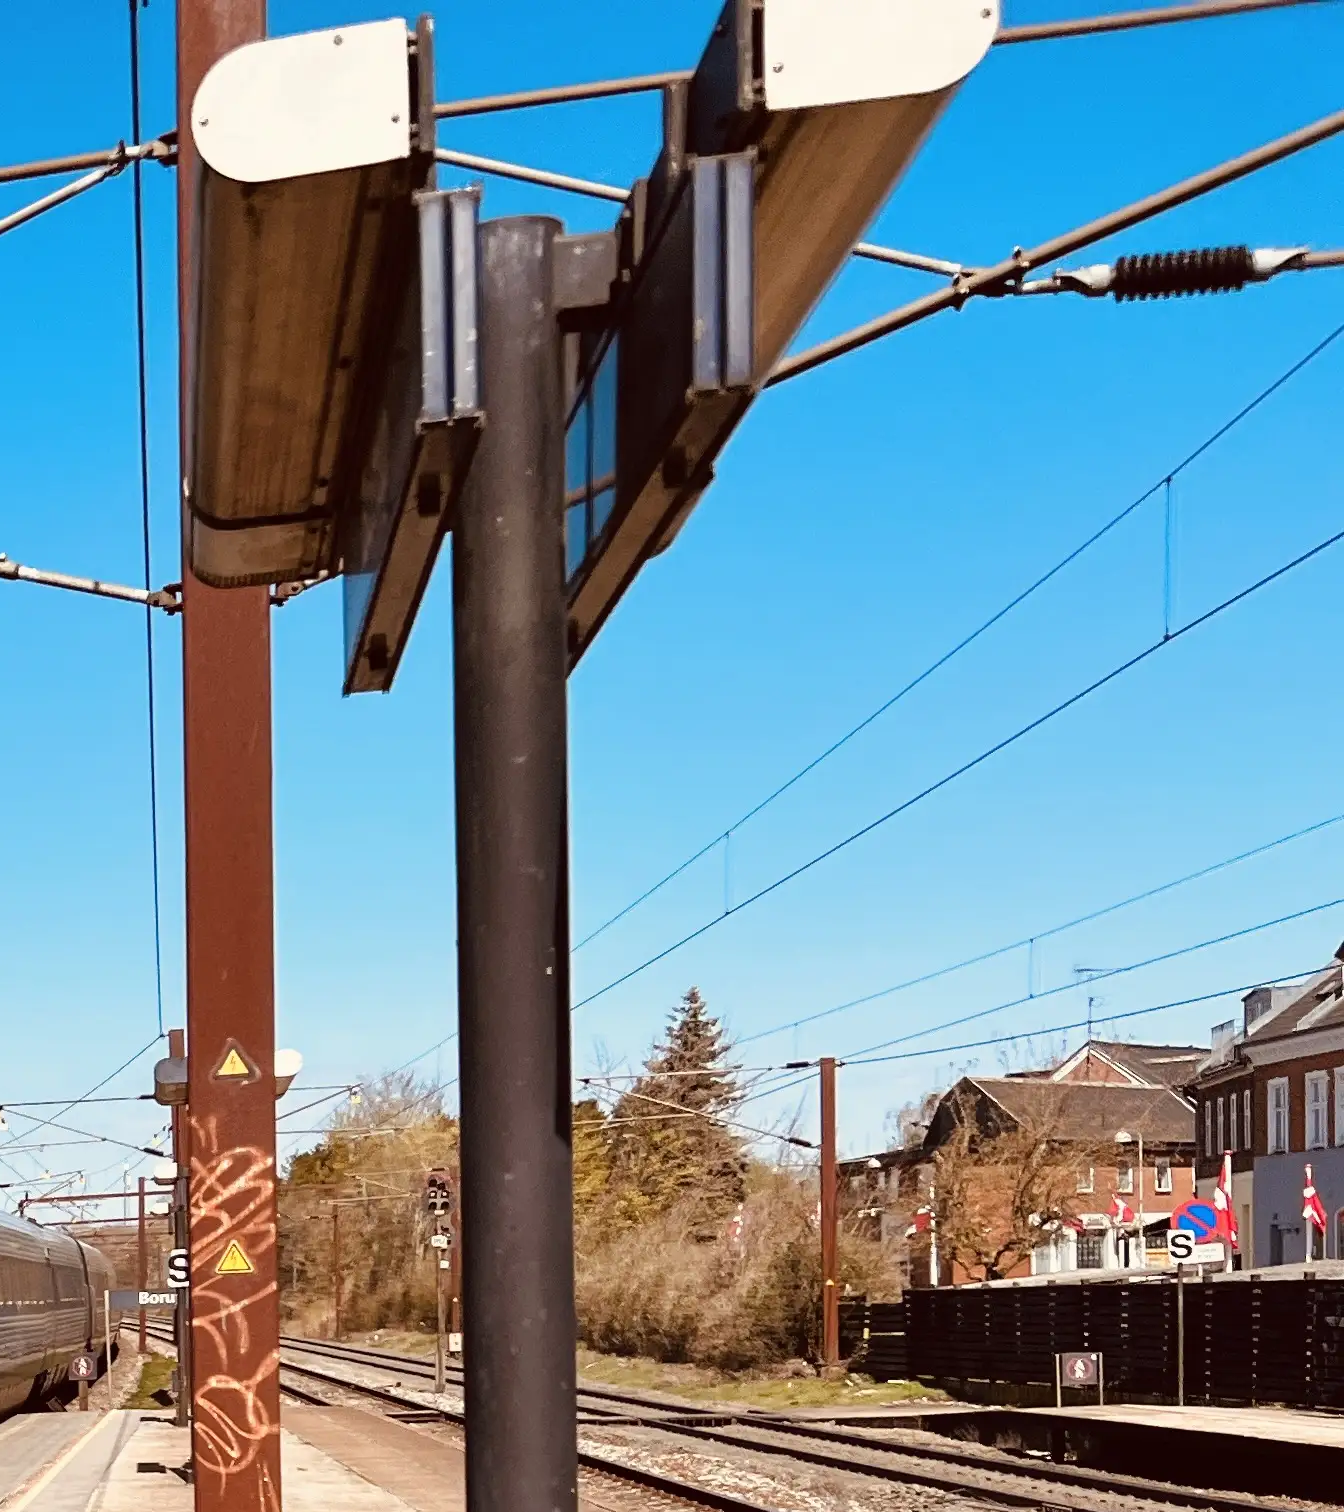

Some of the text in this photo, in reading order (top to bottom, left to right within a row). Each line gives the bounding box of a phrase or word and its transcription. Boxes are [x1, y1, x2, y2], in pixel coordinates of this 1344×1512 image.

[1170, 1234, 1192, 1258] S
[168, 1253, 190, 1283] S
[138, 1291, 179, 1305] Boru
